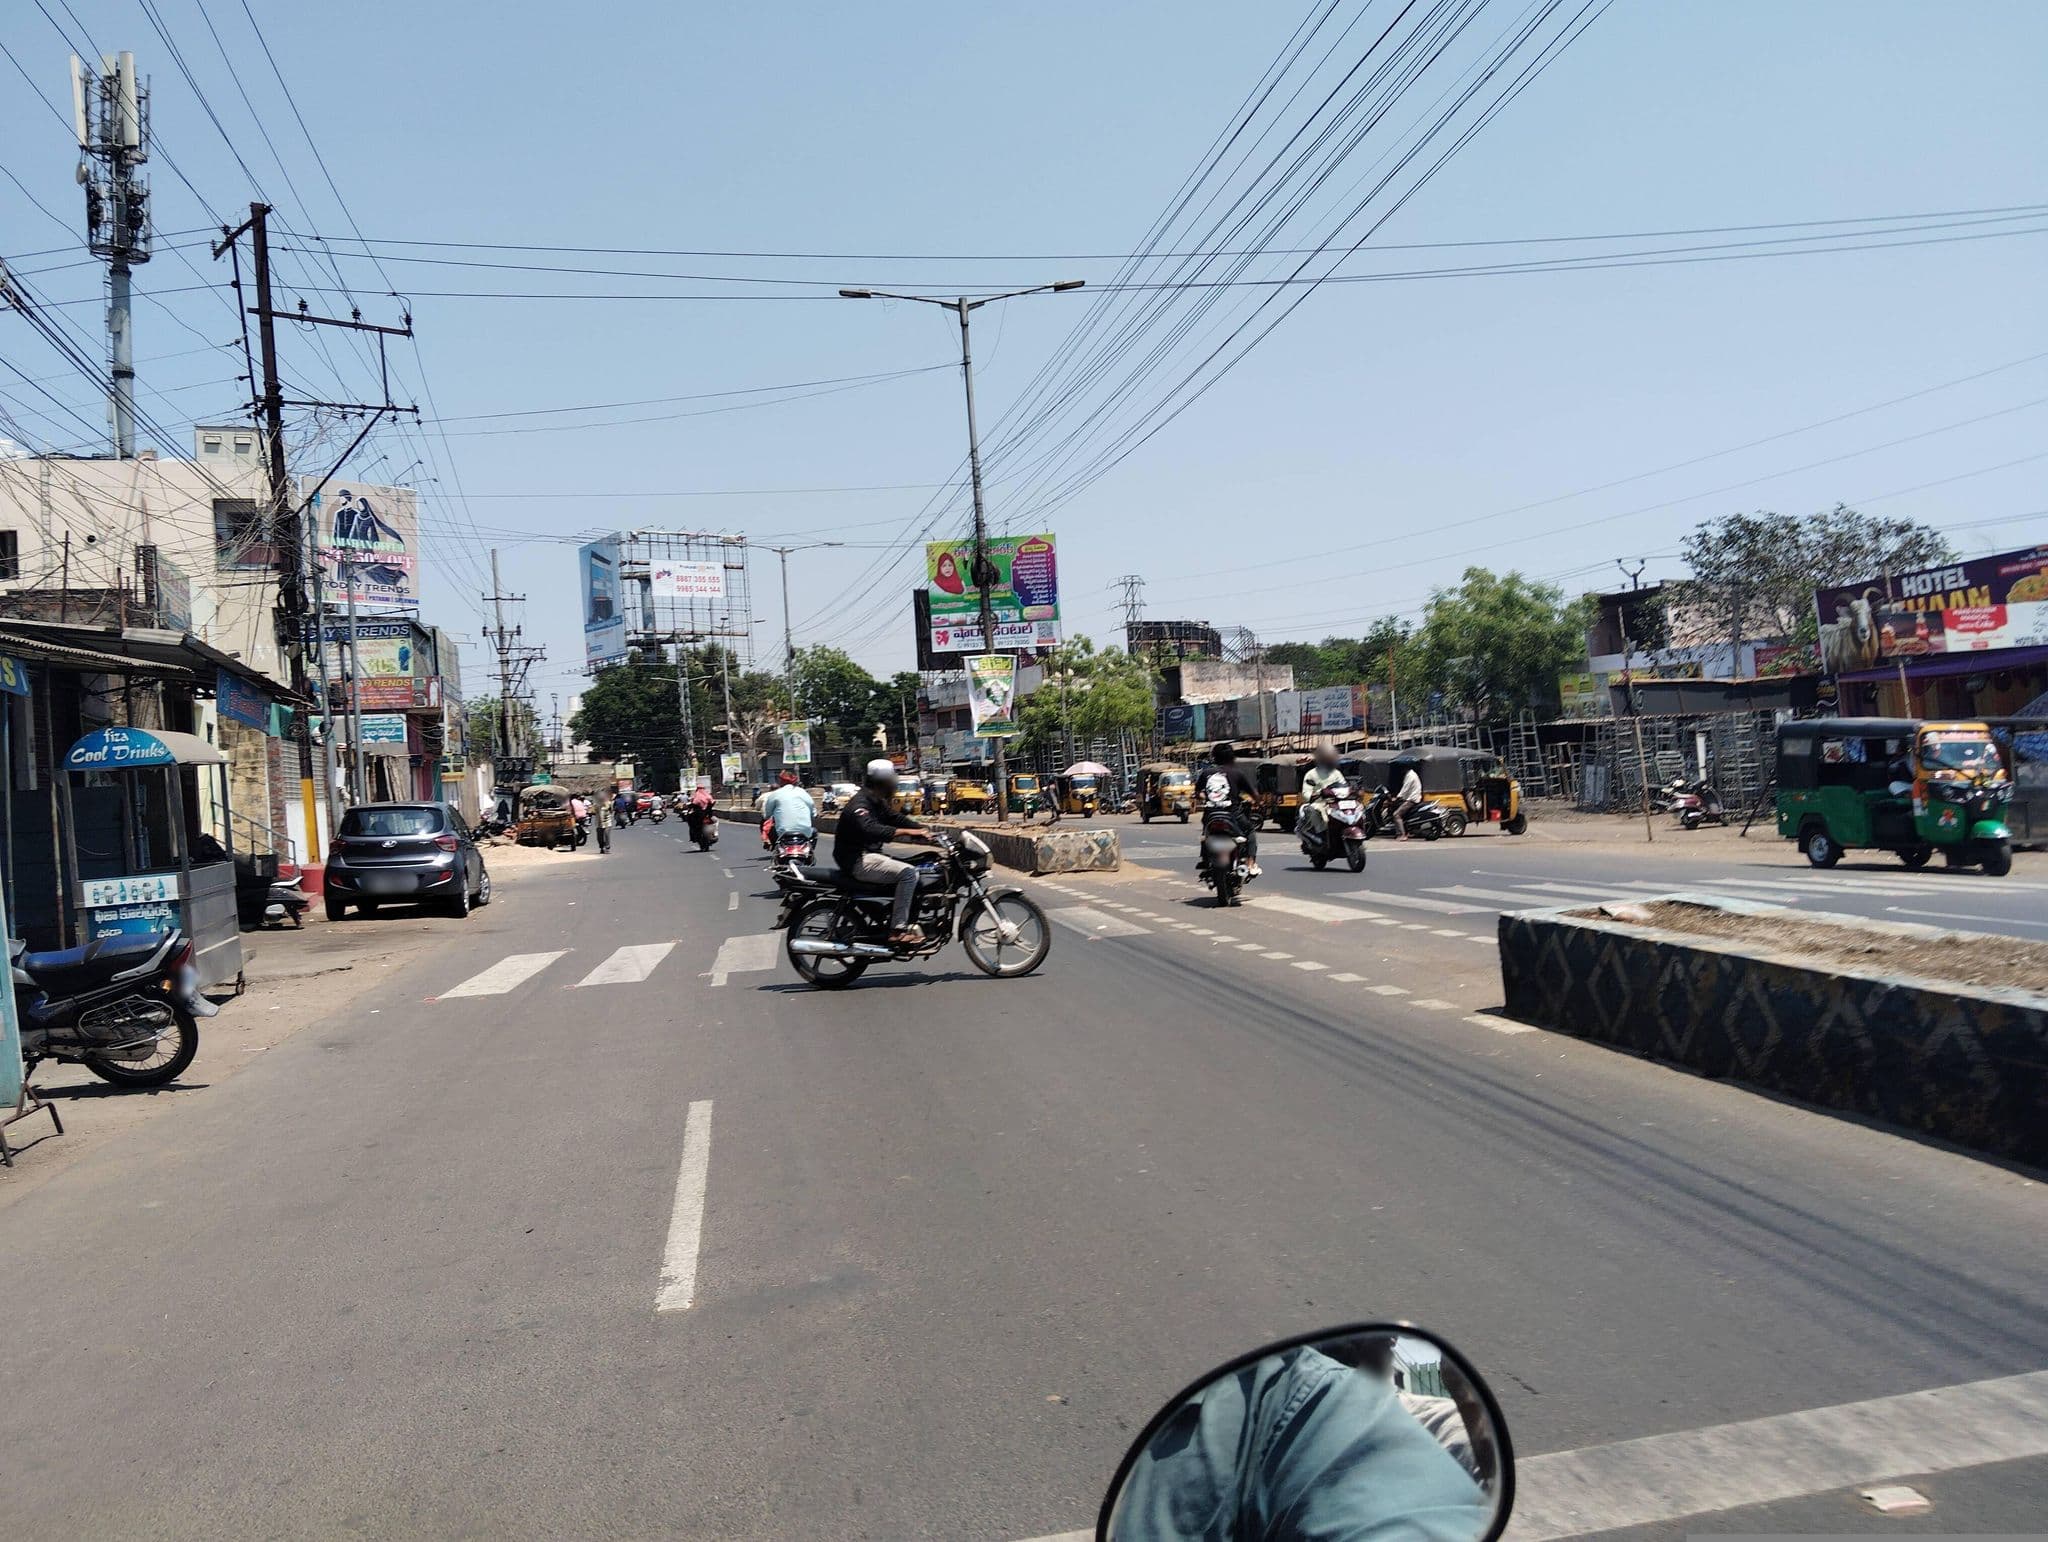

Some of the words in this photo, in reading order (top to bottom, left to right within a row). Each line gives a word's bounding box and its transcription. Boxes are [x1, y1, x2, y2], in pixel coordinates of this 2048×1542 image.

[322, 581, 362, 591] TODY
[365, 584, 411, 594] TRENDS
[1901, 567, 1971, 598] HOTEL
[0, 655, 17, 688] S
[103, 728, 129, 743] fiza
[70, 745, 108, 763] Cool
[112, 742, 166, 760] Drinks
